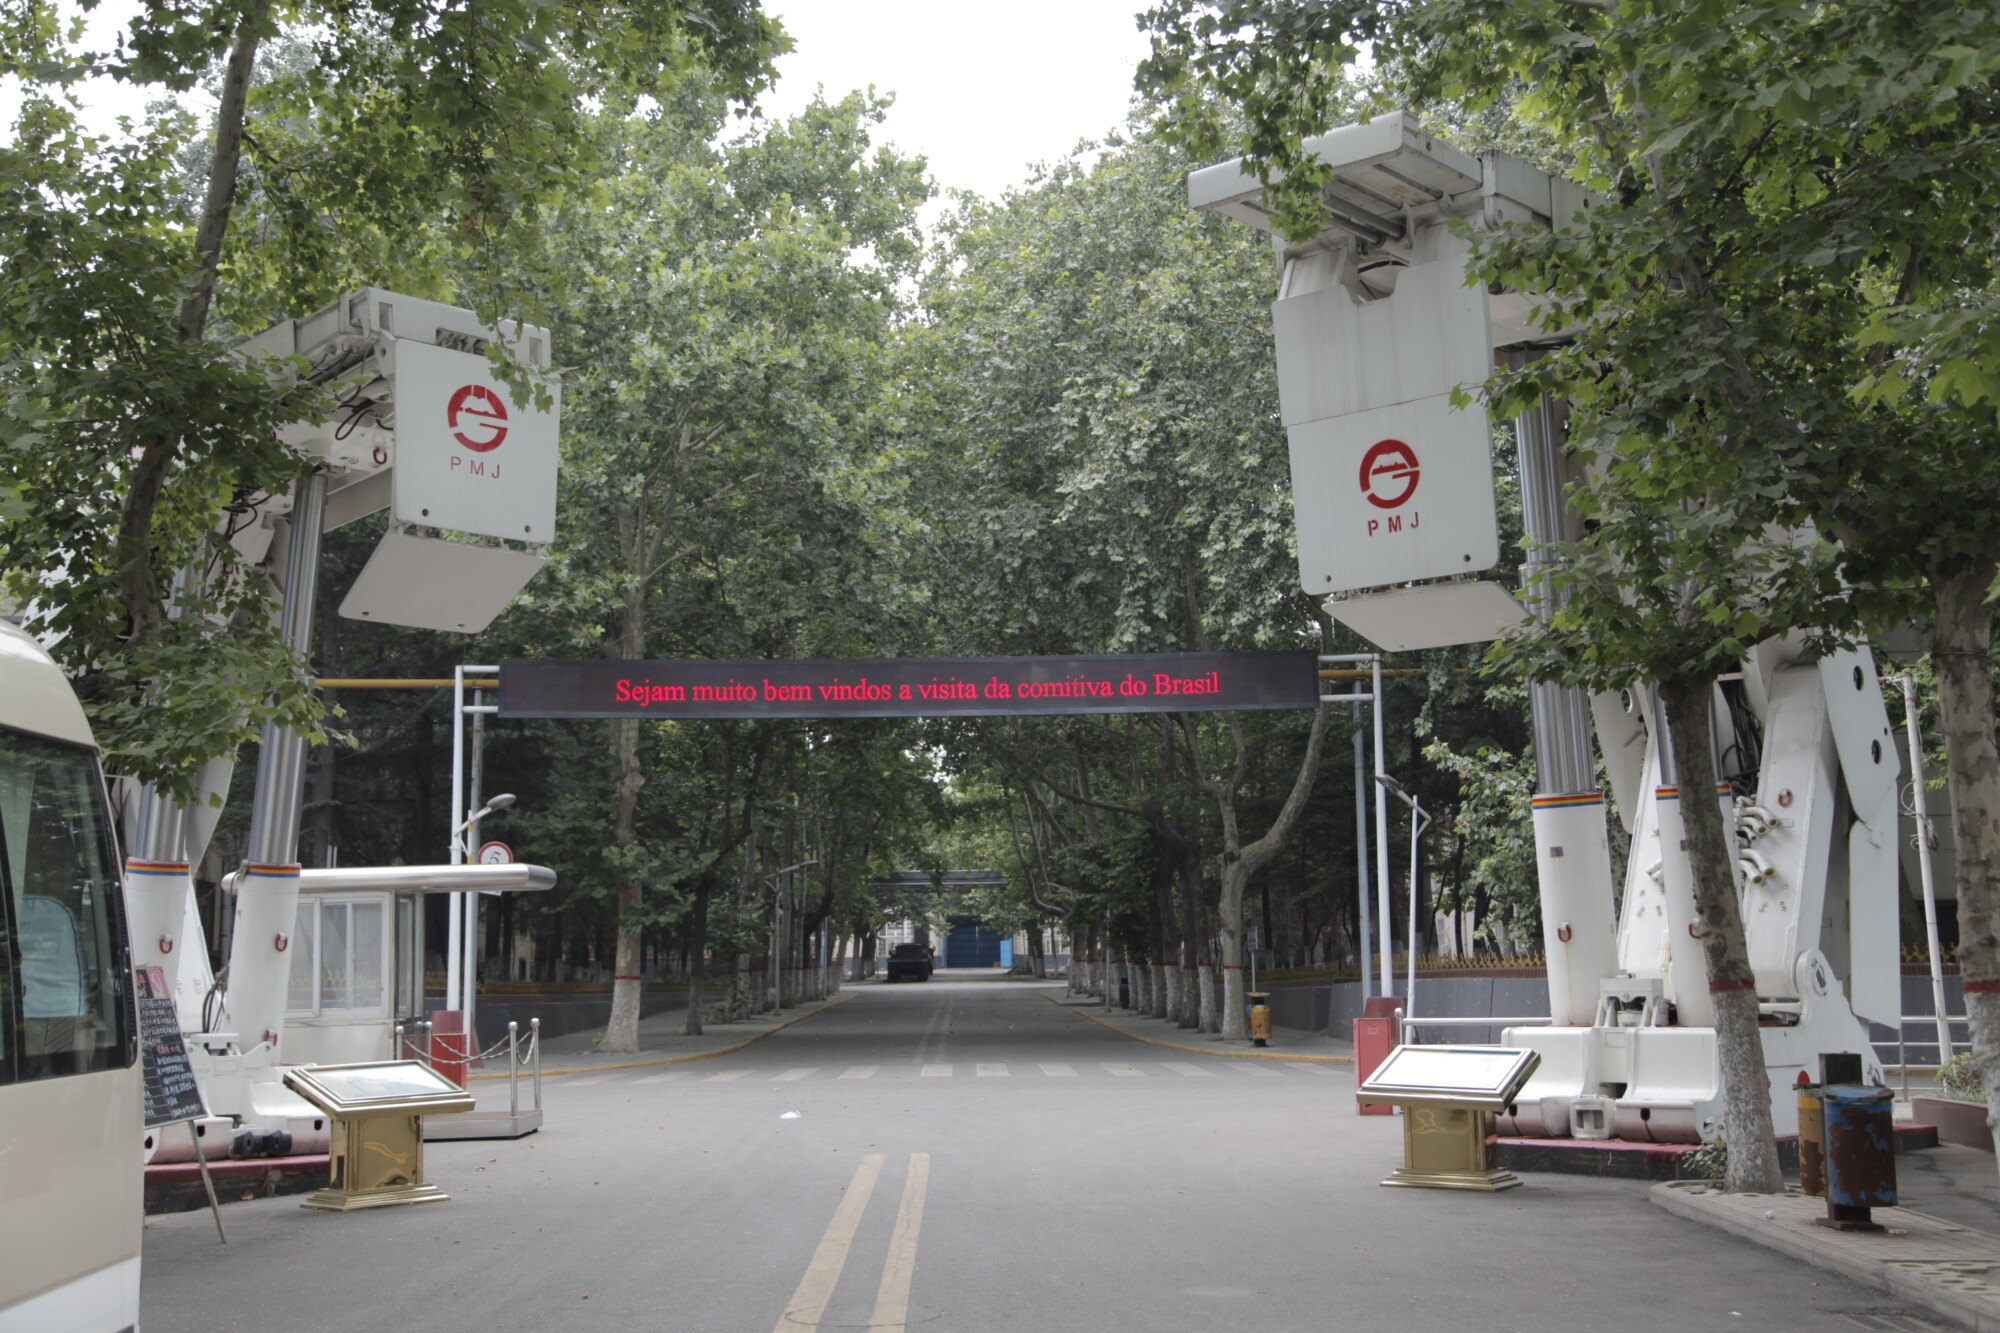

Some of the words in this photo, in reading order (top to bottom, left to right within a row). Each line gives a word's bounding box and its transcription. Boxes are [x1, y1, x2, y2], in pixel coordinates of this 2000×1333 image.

[450, 456, 500, 479] PMJ
[1367, 511, 1419, 537] PMJ
[614, 680, 687, 707] Sejam
[691, 680, 758, 702] muito
[763, 679, 814, 702] bem
[818, 678, 892, 701] vindos
[898, 685, 913, 700] a
[918, 677, 979, 700] visita
[984, 676, 1013, 699] da
[1017, 675, 1114, 699] comitiva
[1119, 673, 1149, 697] do
[1153, 672, 1221, 696] Brasil
